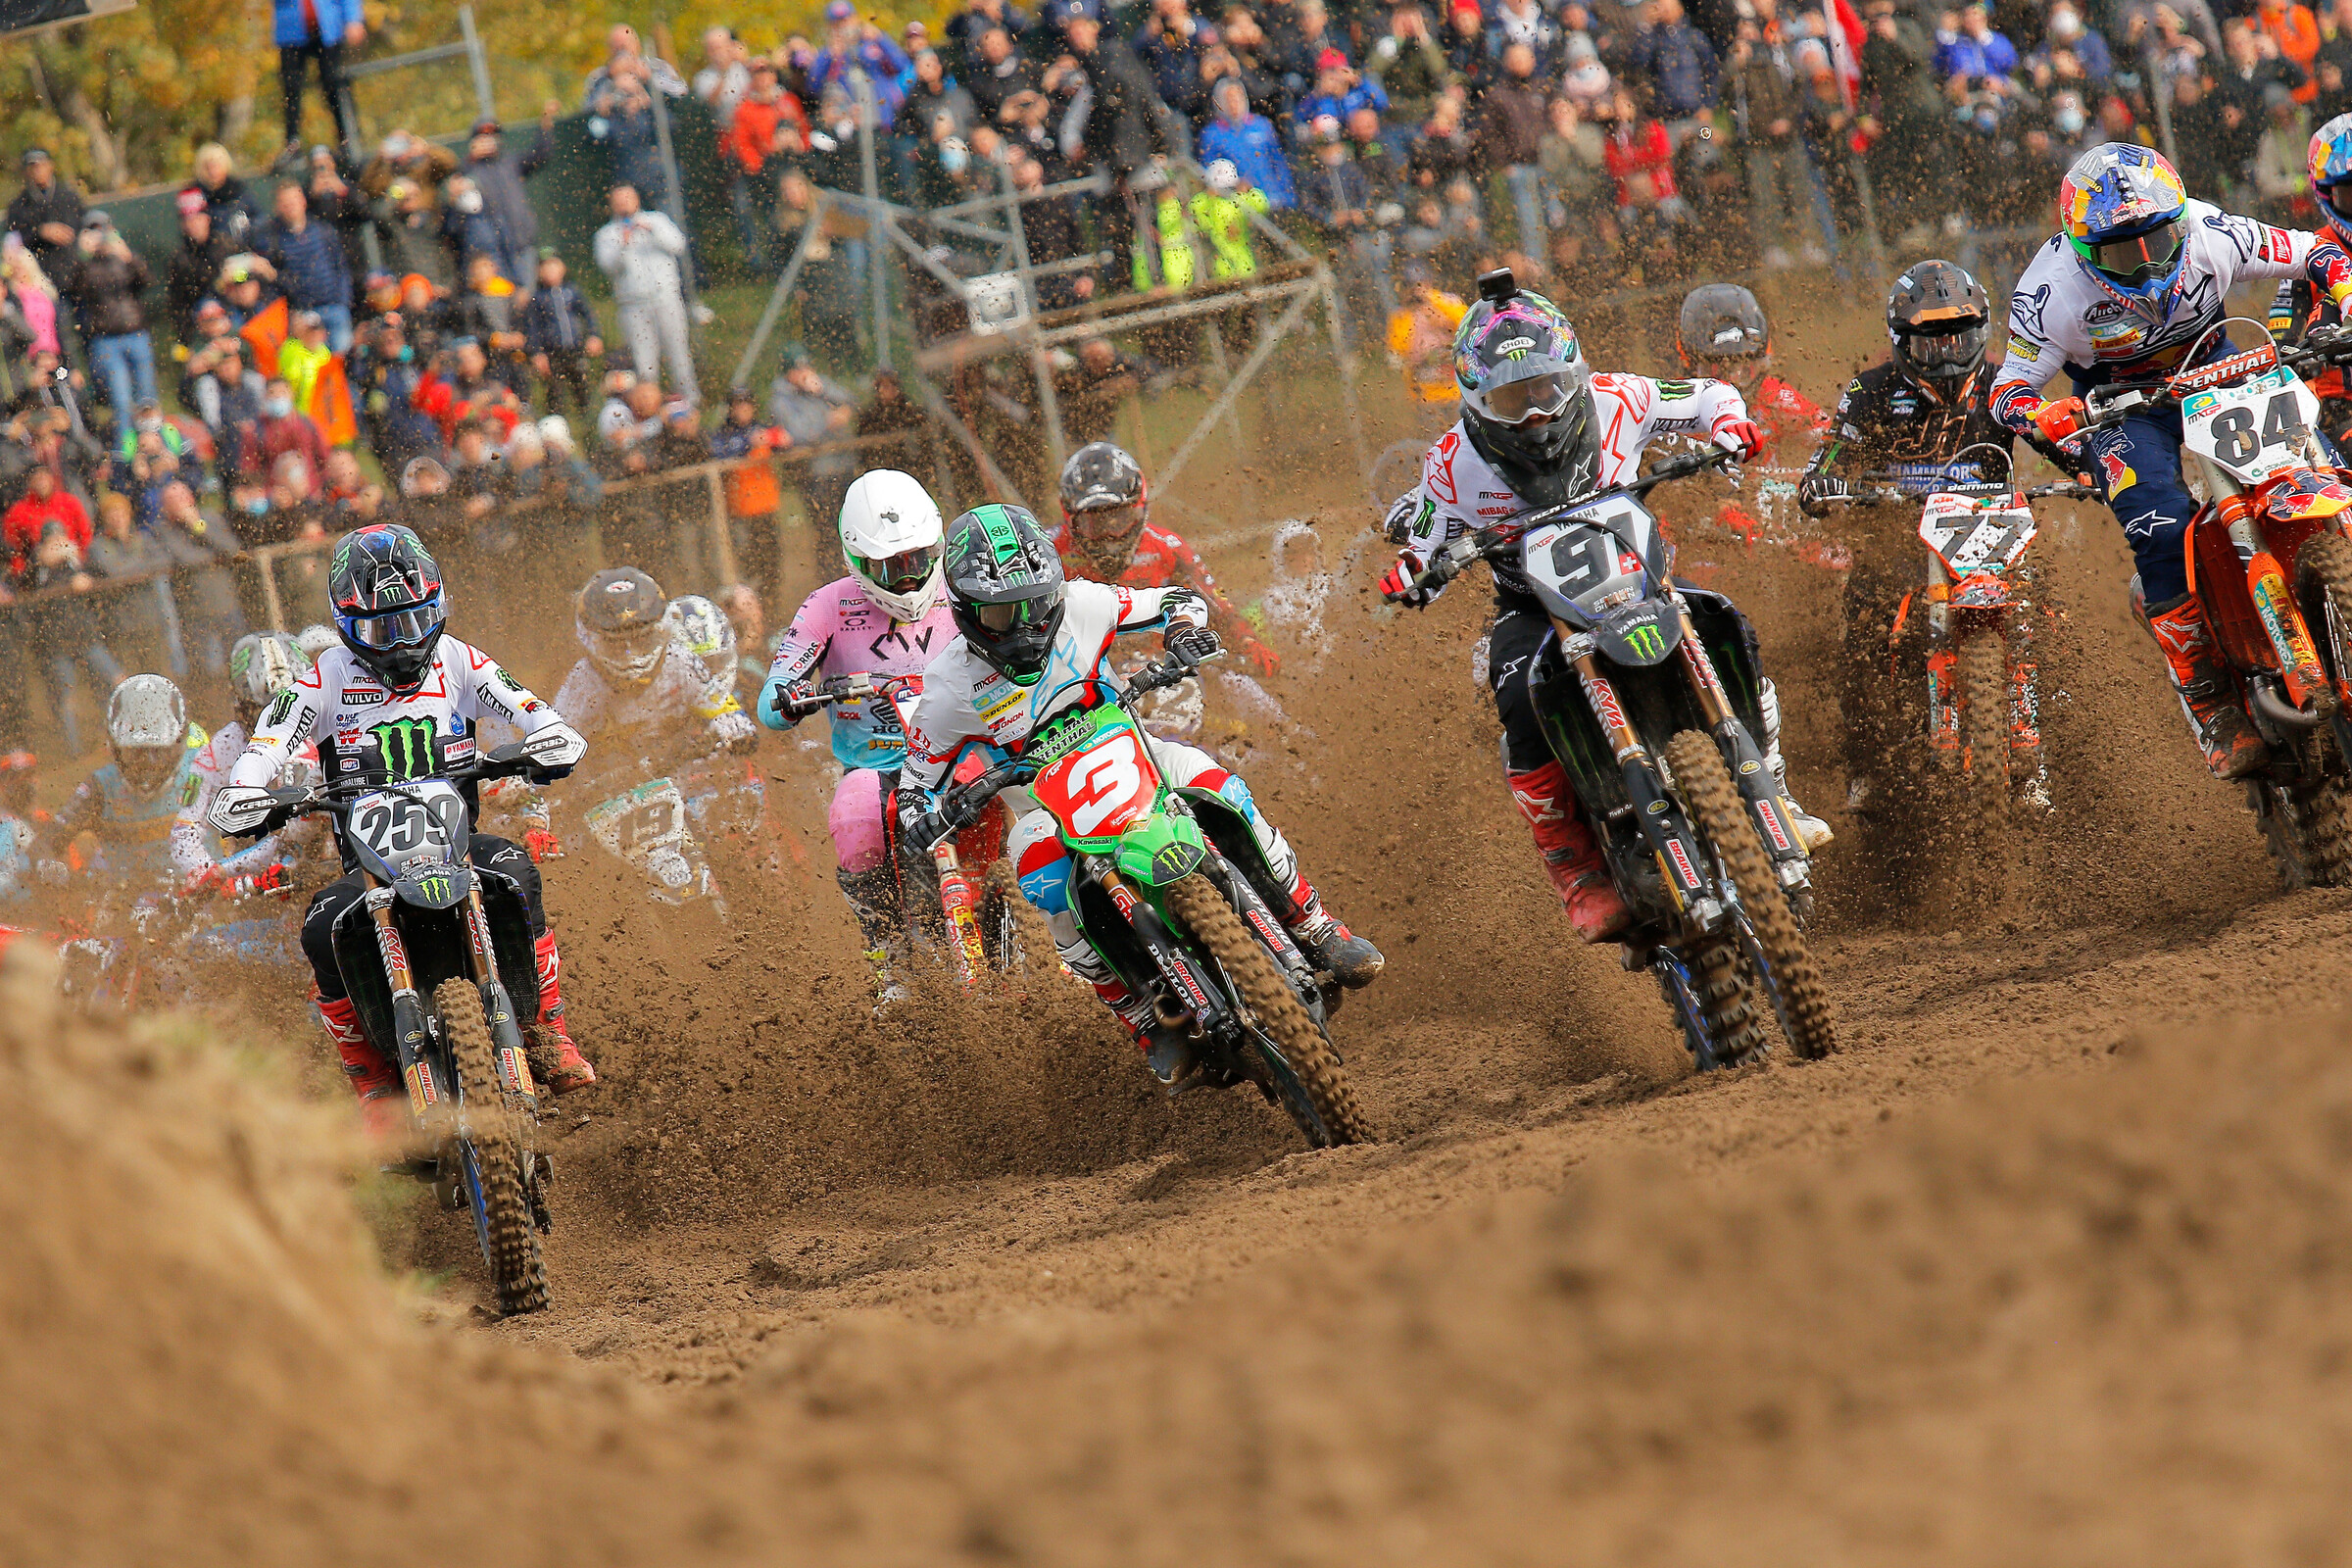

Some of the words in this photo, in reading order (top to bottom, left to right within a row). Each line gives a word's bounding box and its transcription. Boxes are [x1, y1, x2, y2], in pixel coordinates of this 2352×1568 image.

[1500, 338, 1530, 351] SHOEI
[2210, 390, 2309, 467] 84
[1478, 491, 1514, 500] MXGP
[1946, 482, 2004, 492] domino
[1530, 489, 1601, 522] RENHAL
[1528, 533, 1555, 555] MXGP
[1935, 514, 2035, 564] 77
[1550, 511, 1642, 602] 91
[1617, 613, 1659, 636] YAMAHA
[2261, 606, 2296, 671] MOTOREX
[788, 641, 819, 675] TORROS
[343, 692, 382, 704] WILVO
[478, 685, 514, 722] AMAHA
[989, 692, 1024, 717] DUNLOP
[1589, 677, 1627, 729] KYB
[286, 708, 315, 753] YAMAHA
[451, 739, 475, 753] YAMAHA
[520, 737, 566, 755] ACERBIS
[1092, 724, 1126, 744] MOTOREX
[1067, 734, 1141, 837] 3
[231, 798, 278, 812] ACERBIS
[354, 799, 380, 813] MXGP
[360, 793, 461, 858] 259
[1758, 802, 1788, 849] BRAKING
[413, 869, 452, 882] YAMAHA
[1668, 840, 1698, 887] BRAKING
[1247, 909, 1285, 952] BRAKING
[381, 926, 408, 971] KYB
[1173, 960, 1208, 1006] BRAKING
